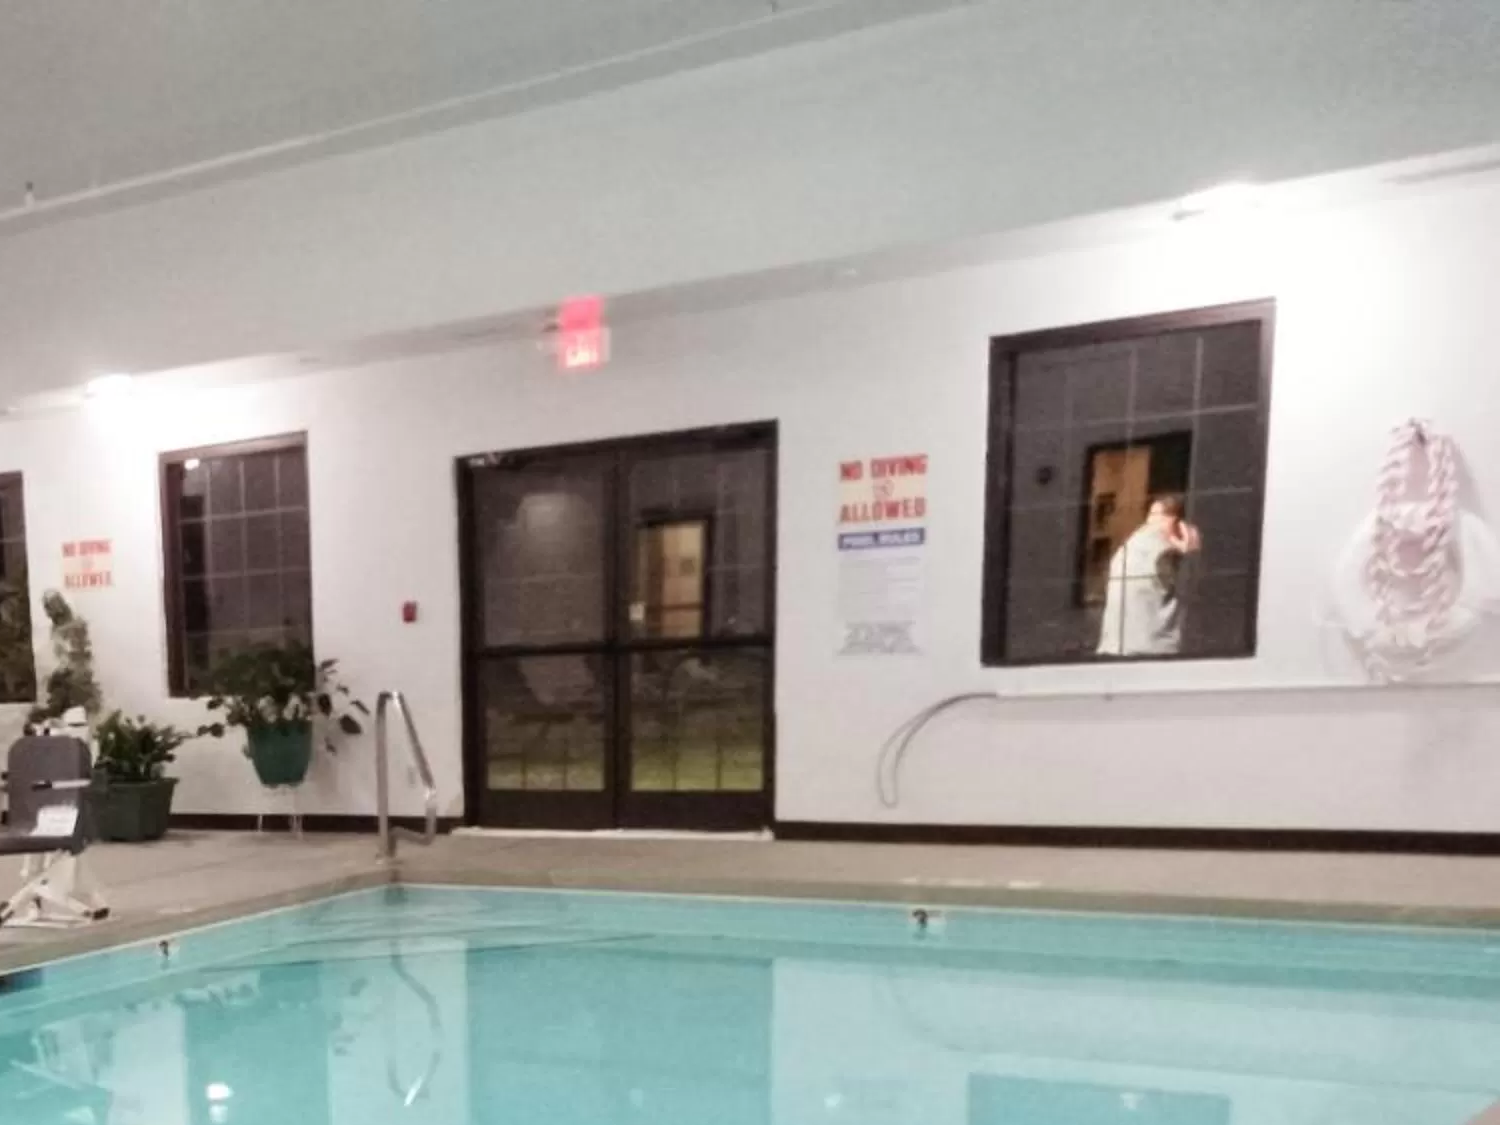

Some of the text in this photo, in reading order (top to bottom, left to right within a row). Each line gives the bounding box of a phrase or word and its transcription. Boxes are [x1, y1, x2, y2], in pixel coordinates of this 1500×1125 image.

[840, 454, 927, 481] NO DIVING
[840, 497, 925, 523] ALLOWED
